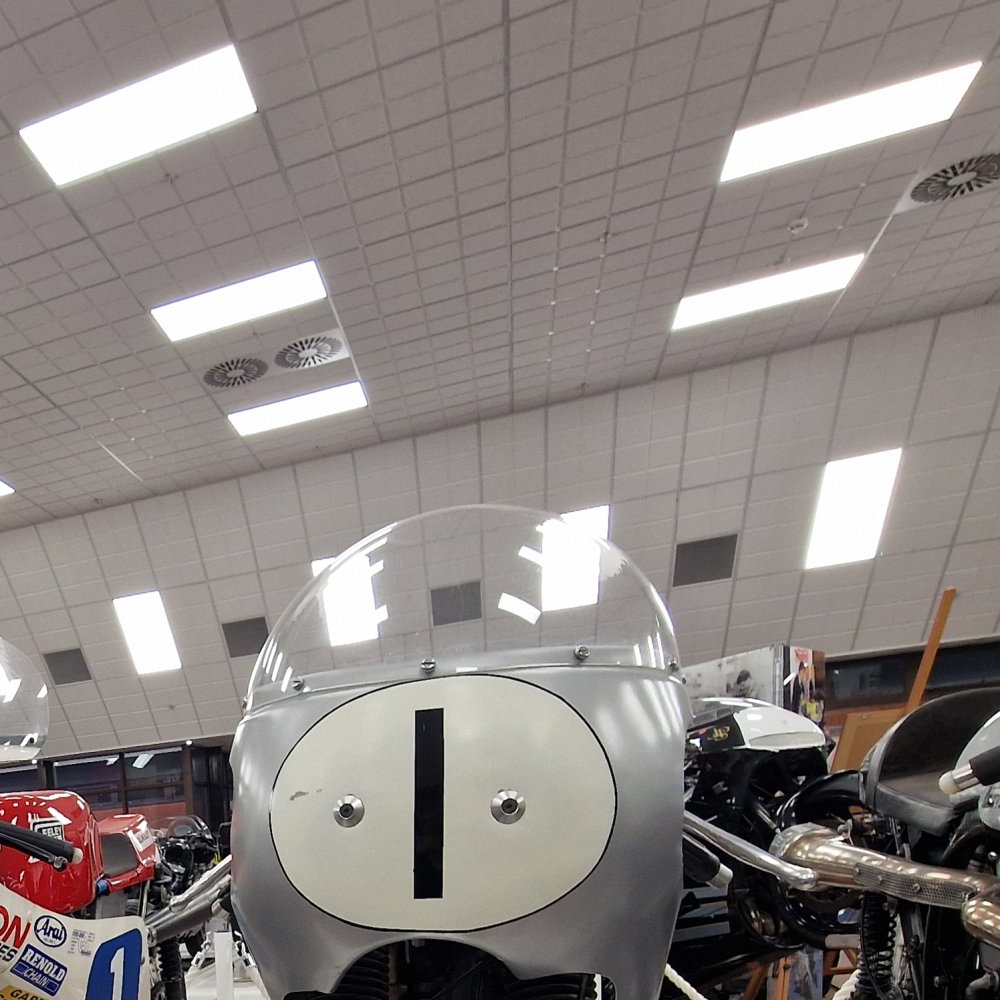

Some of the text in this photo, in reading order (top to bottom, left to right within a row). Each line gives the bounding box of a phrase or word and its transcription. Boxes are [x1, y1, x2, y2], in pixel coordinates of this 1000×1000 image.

[35, 919, 64, 941] Arai
[21, 949, 66, 982] RENOLD
[23, 967, 50, 987] CHAIN
